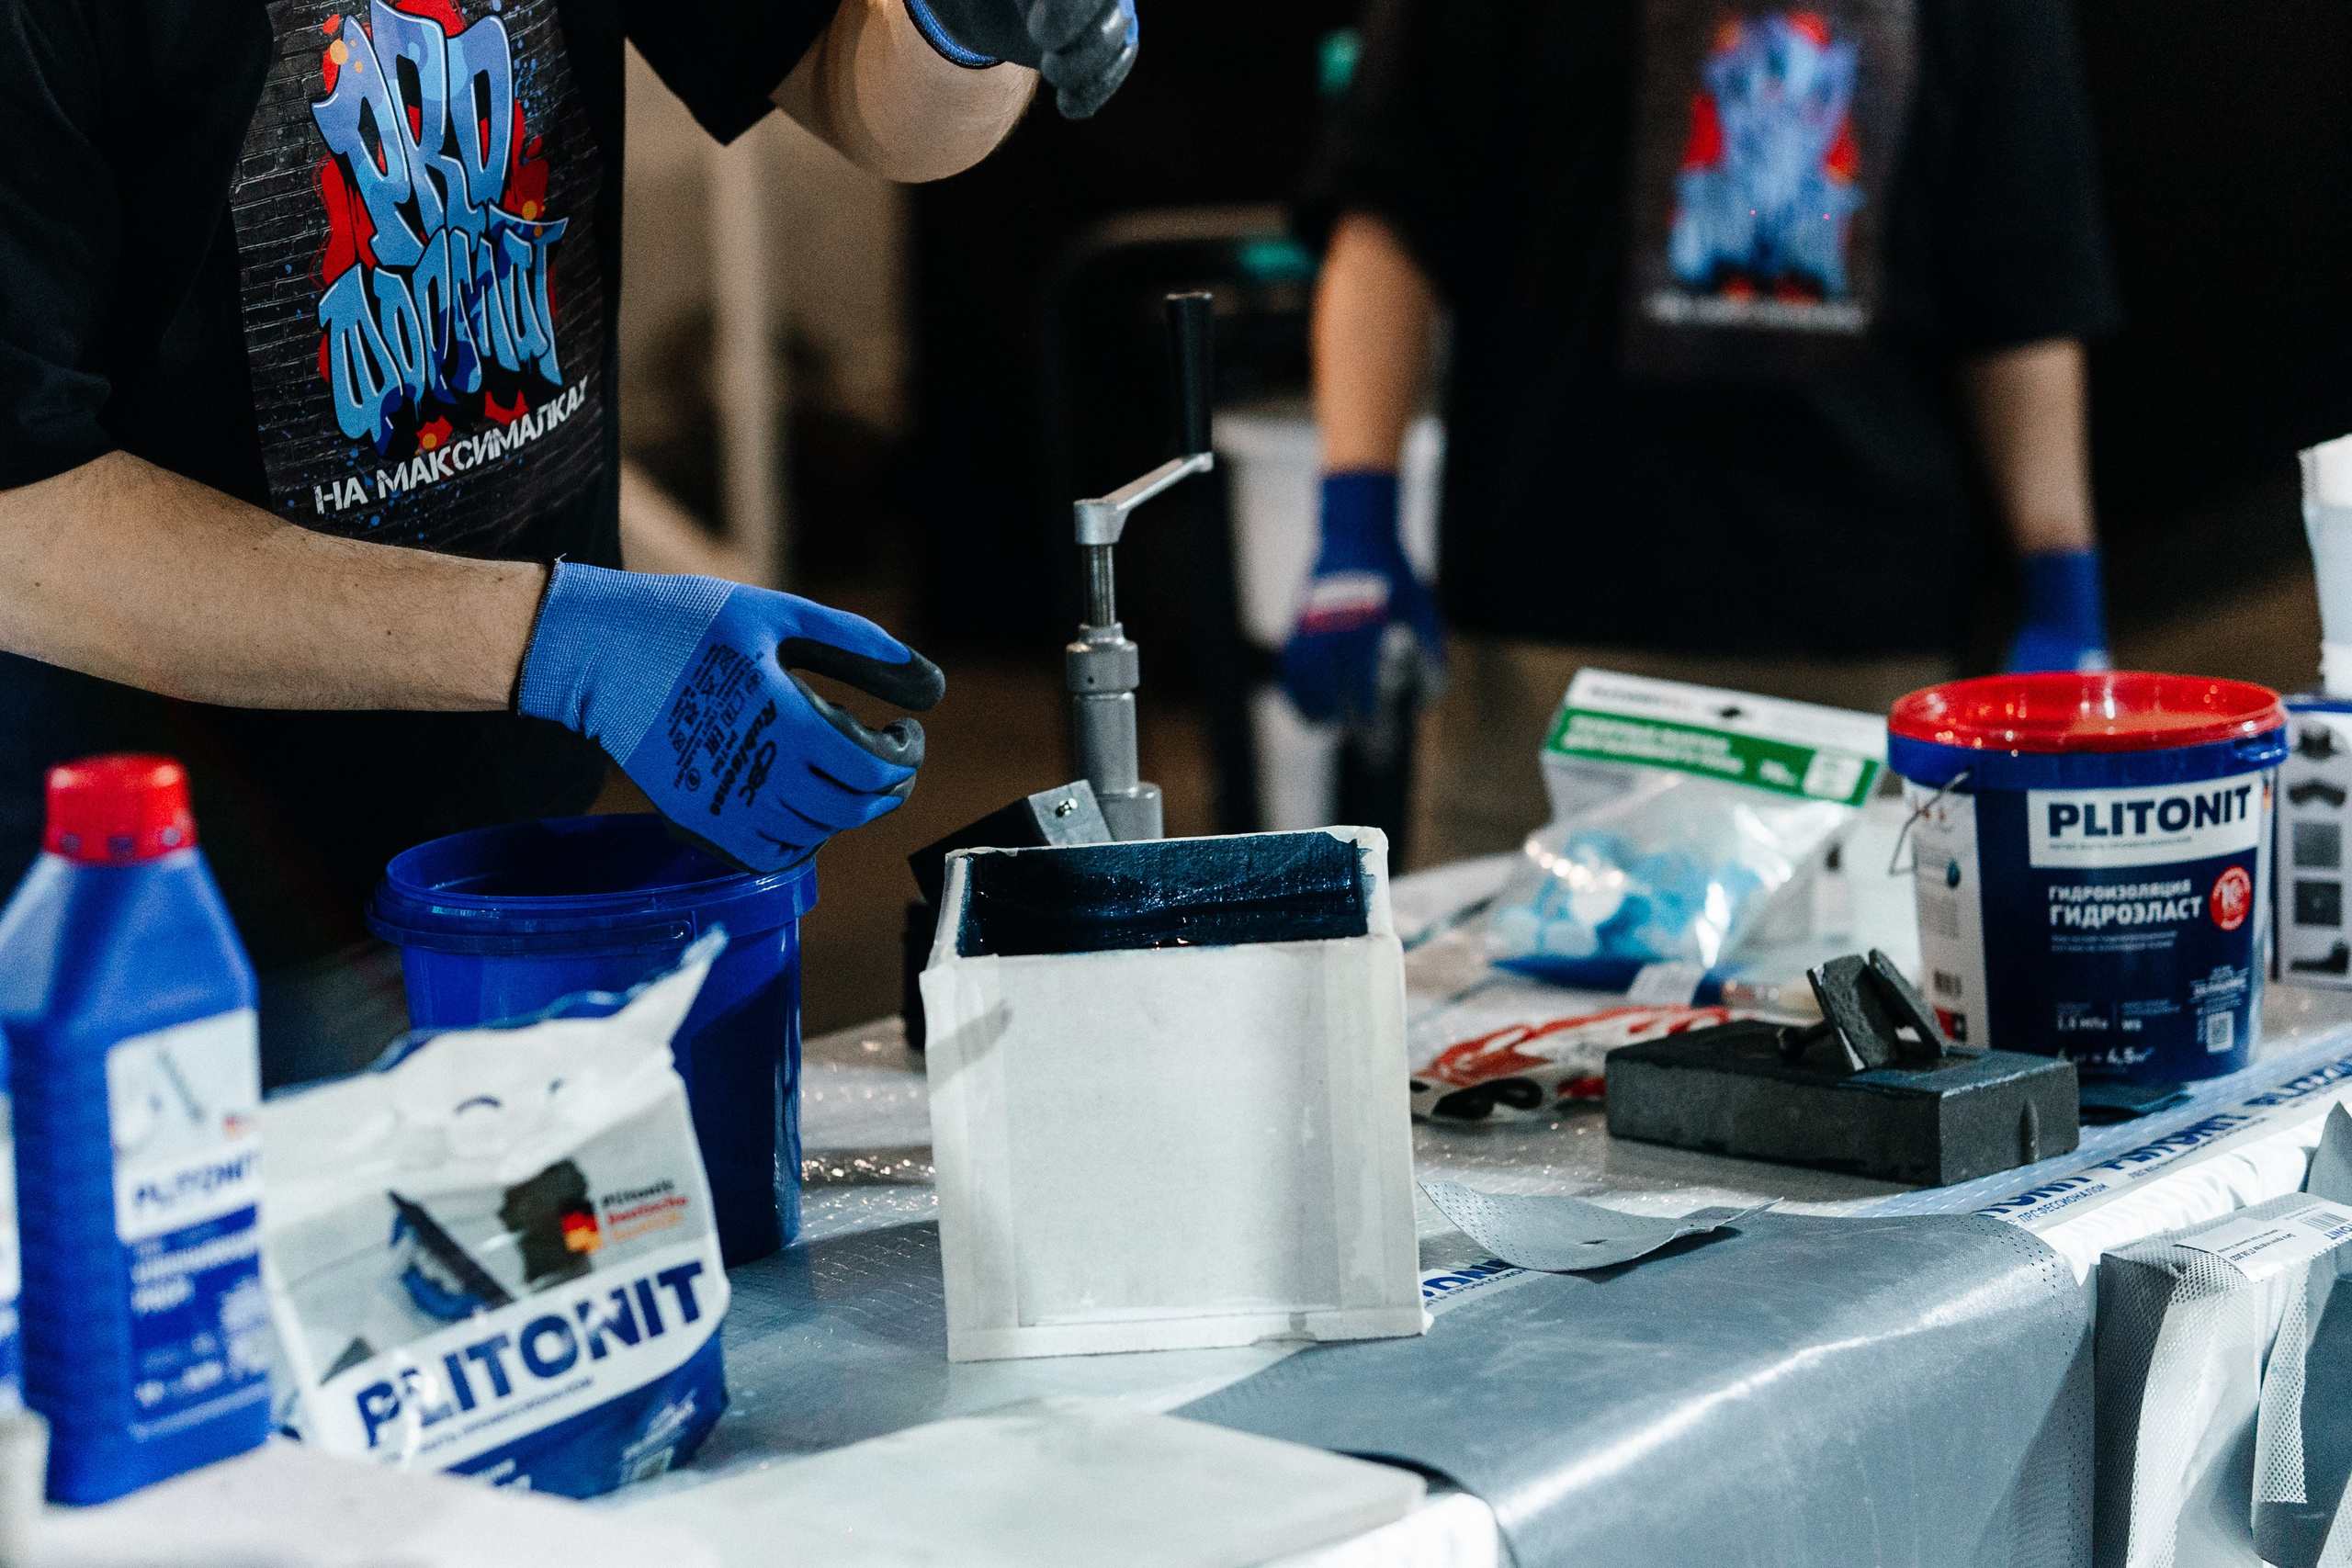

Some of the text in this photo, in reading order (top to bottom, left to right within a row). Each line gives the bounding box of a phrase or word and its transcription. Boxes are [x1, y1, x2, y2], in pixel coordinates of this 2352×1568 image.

[314, 476, 368, 514] НА
[2048, 784, 2251, 837] PLITONIT
[2048, 878, 2192, 904] ГИДРОИЗОЛЯЦИЯ
[2049, 896, 2203, 930] ГИДРОЭЛАСТ
[2017, 1182, 2110, 1224] ПРОФЕССИОНАЛОМ
